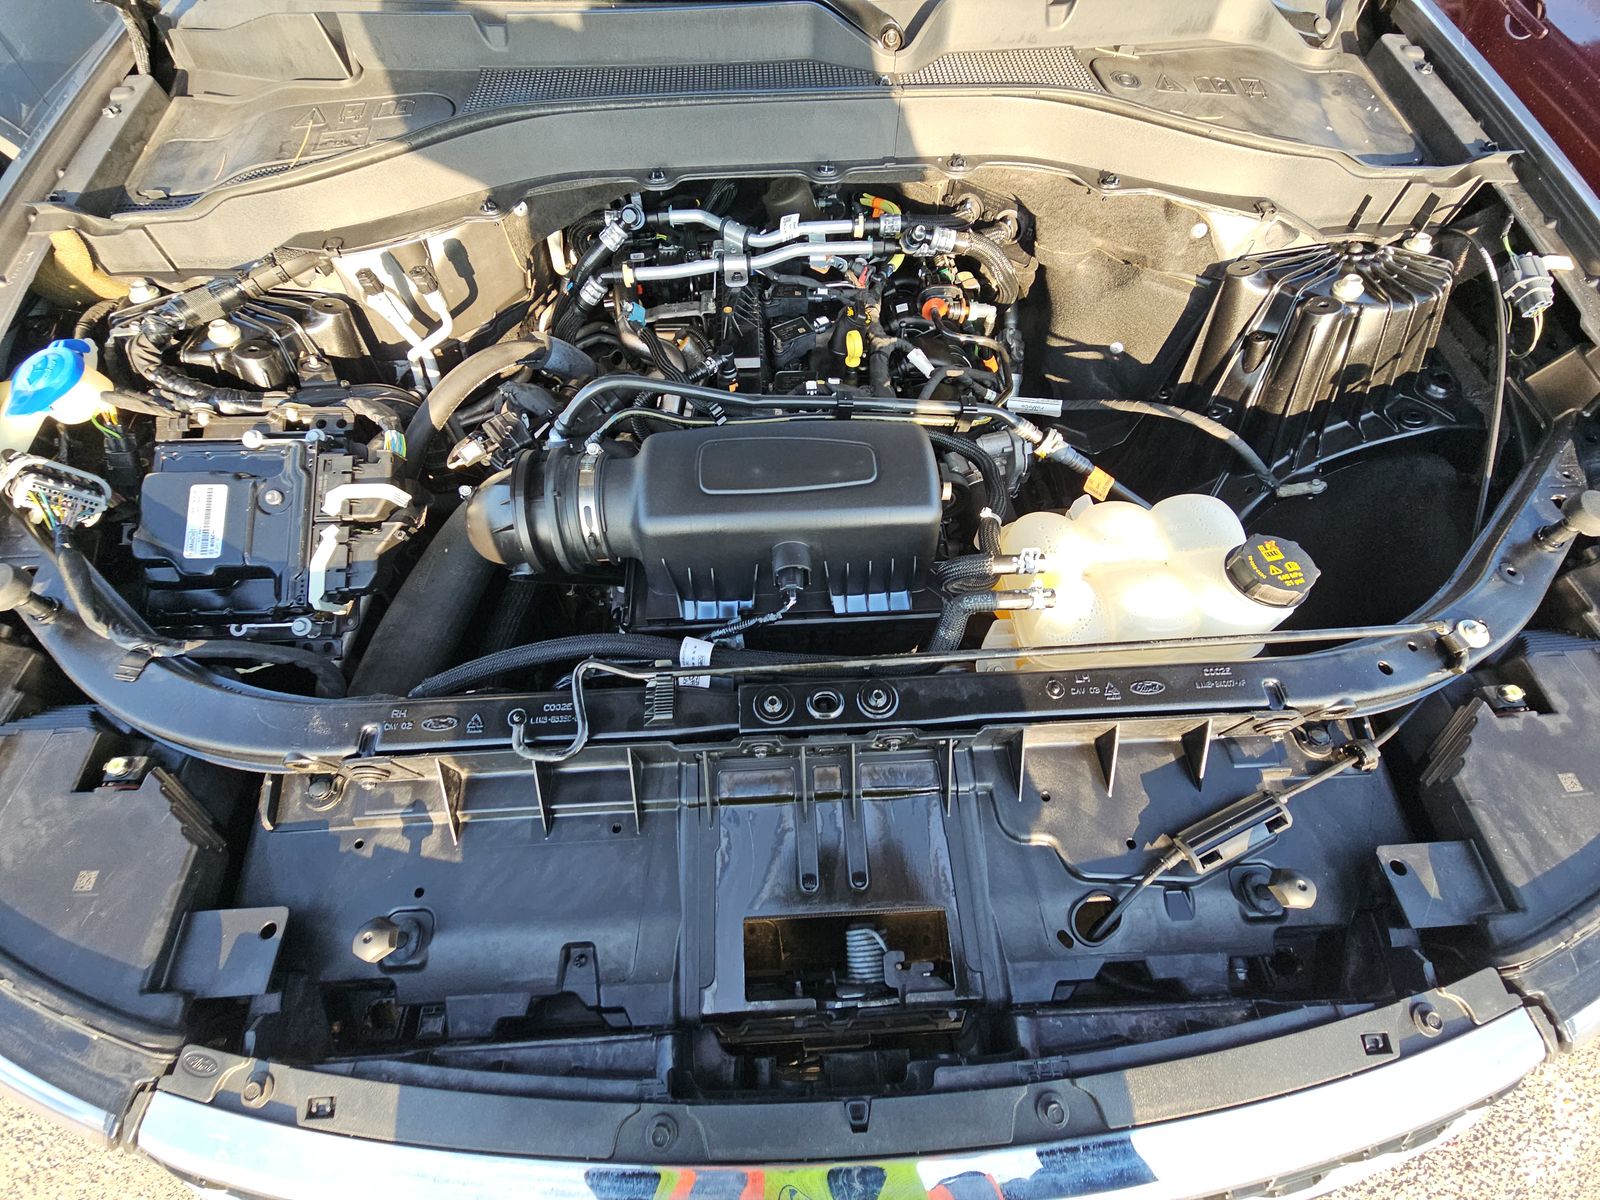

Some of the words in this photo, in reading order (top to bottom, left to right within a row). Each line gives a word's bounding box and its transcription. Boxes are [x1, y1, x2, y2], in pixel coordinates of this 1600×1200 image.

[1075, 673, 1091, 684] LH
[1133, 681, 1162, 693] Ford
[391, 709, 407, 718] RH
[400, 721, 413, 730] 02
